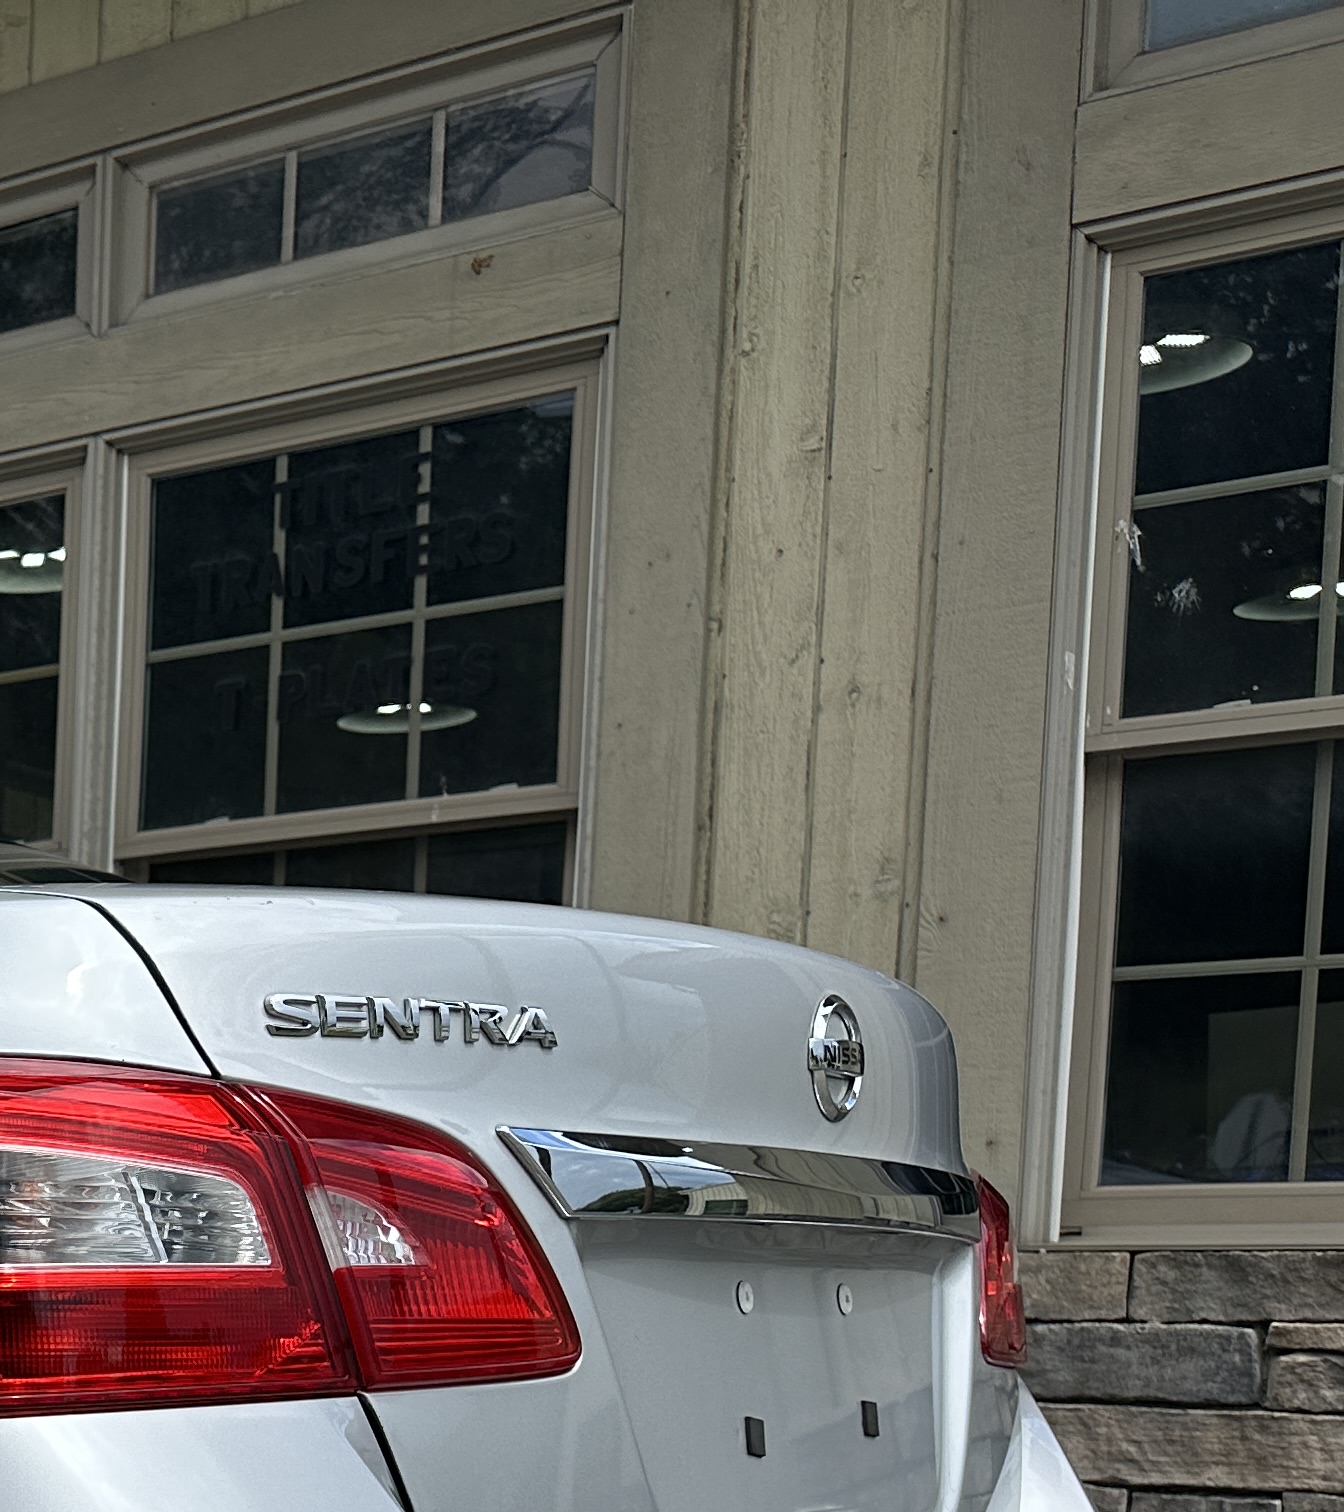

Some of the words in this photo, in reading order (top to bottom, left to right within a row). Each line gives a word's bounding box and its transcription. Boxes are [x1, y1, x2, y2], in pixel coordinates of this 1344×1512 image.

[273, 451, 432, 529] TITLE
[189, 511, 515, 613] TRANSFERS
[263, 993, 559, 1048] SENTRA
